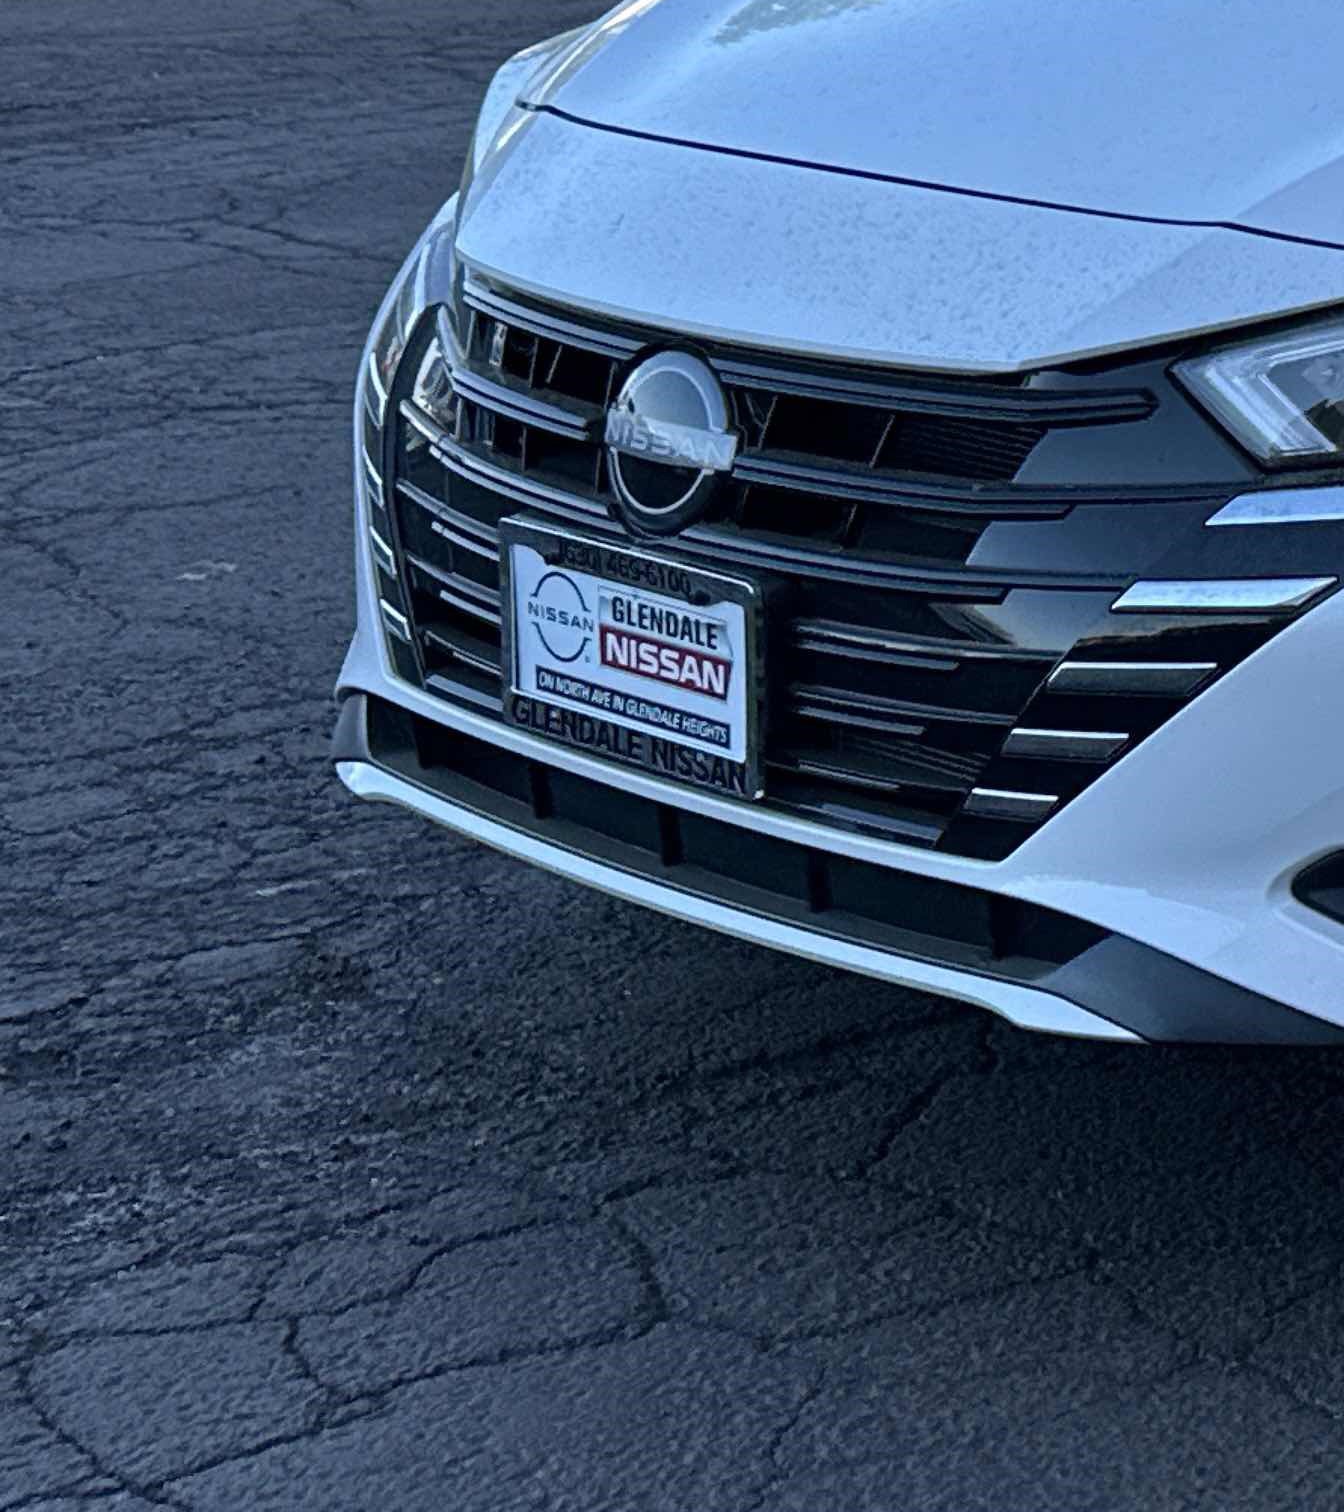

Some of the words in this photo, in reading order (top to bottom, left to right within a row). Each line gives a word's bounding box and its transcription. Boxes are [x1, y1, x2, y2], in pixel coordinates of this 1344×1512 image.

[527, 599, 595, 633] NISSAN
[611, 595, 718, 650] GLENDALE
[605, 632, 725, 696] NISSAN
[539, 671, 554, 688] ON
[625, 697, 681, 727] GLENDALE
[682, 714, 728, 744] HEIGHTS
[514, 697, 643, 757] GLENDALE
[652, 739, 745, 793] NISSAN
